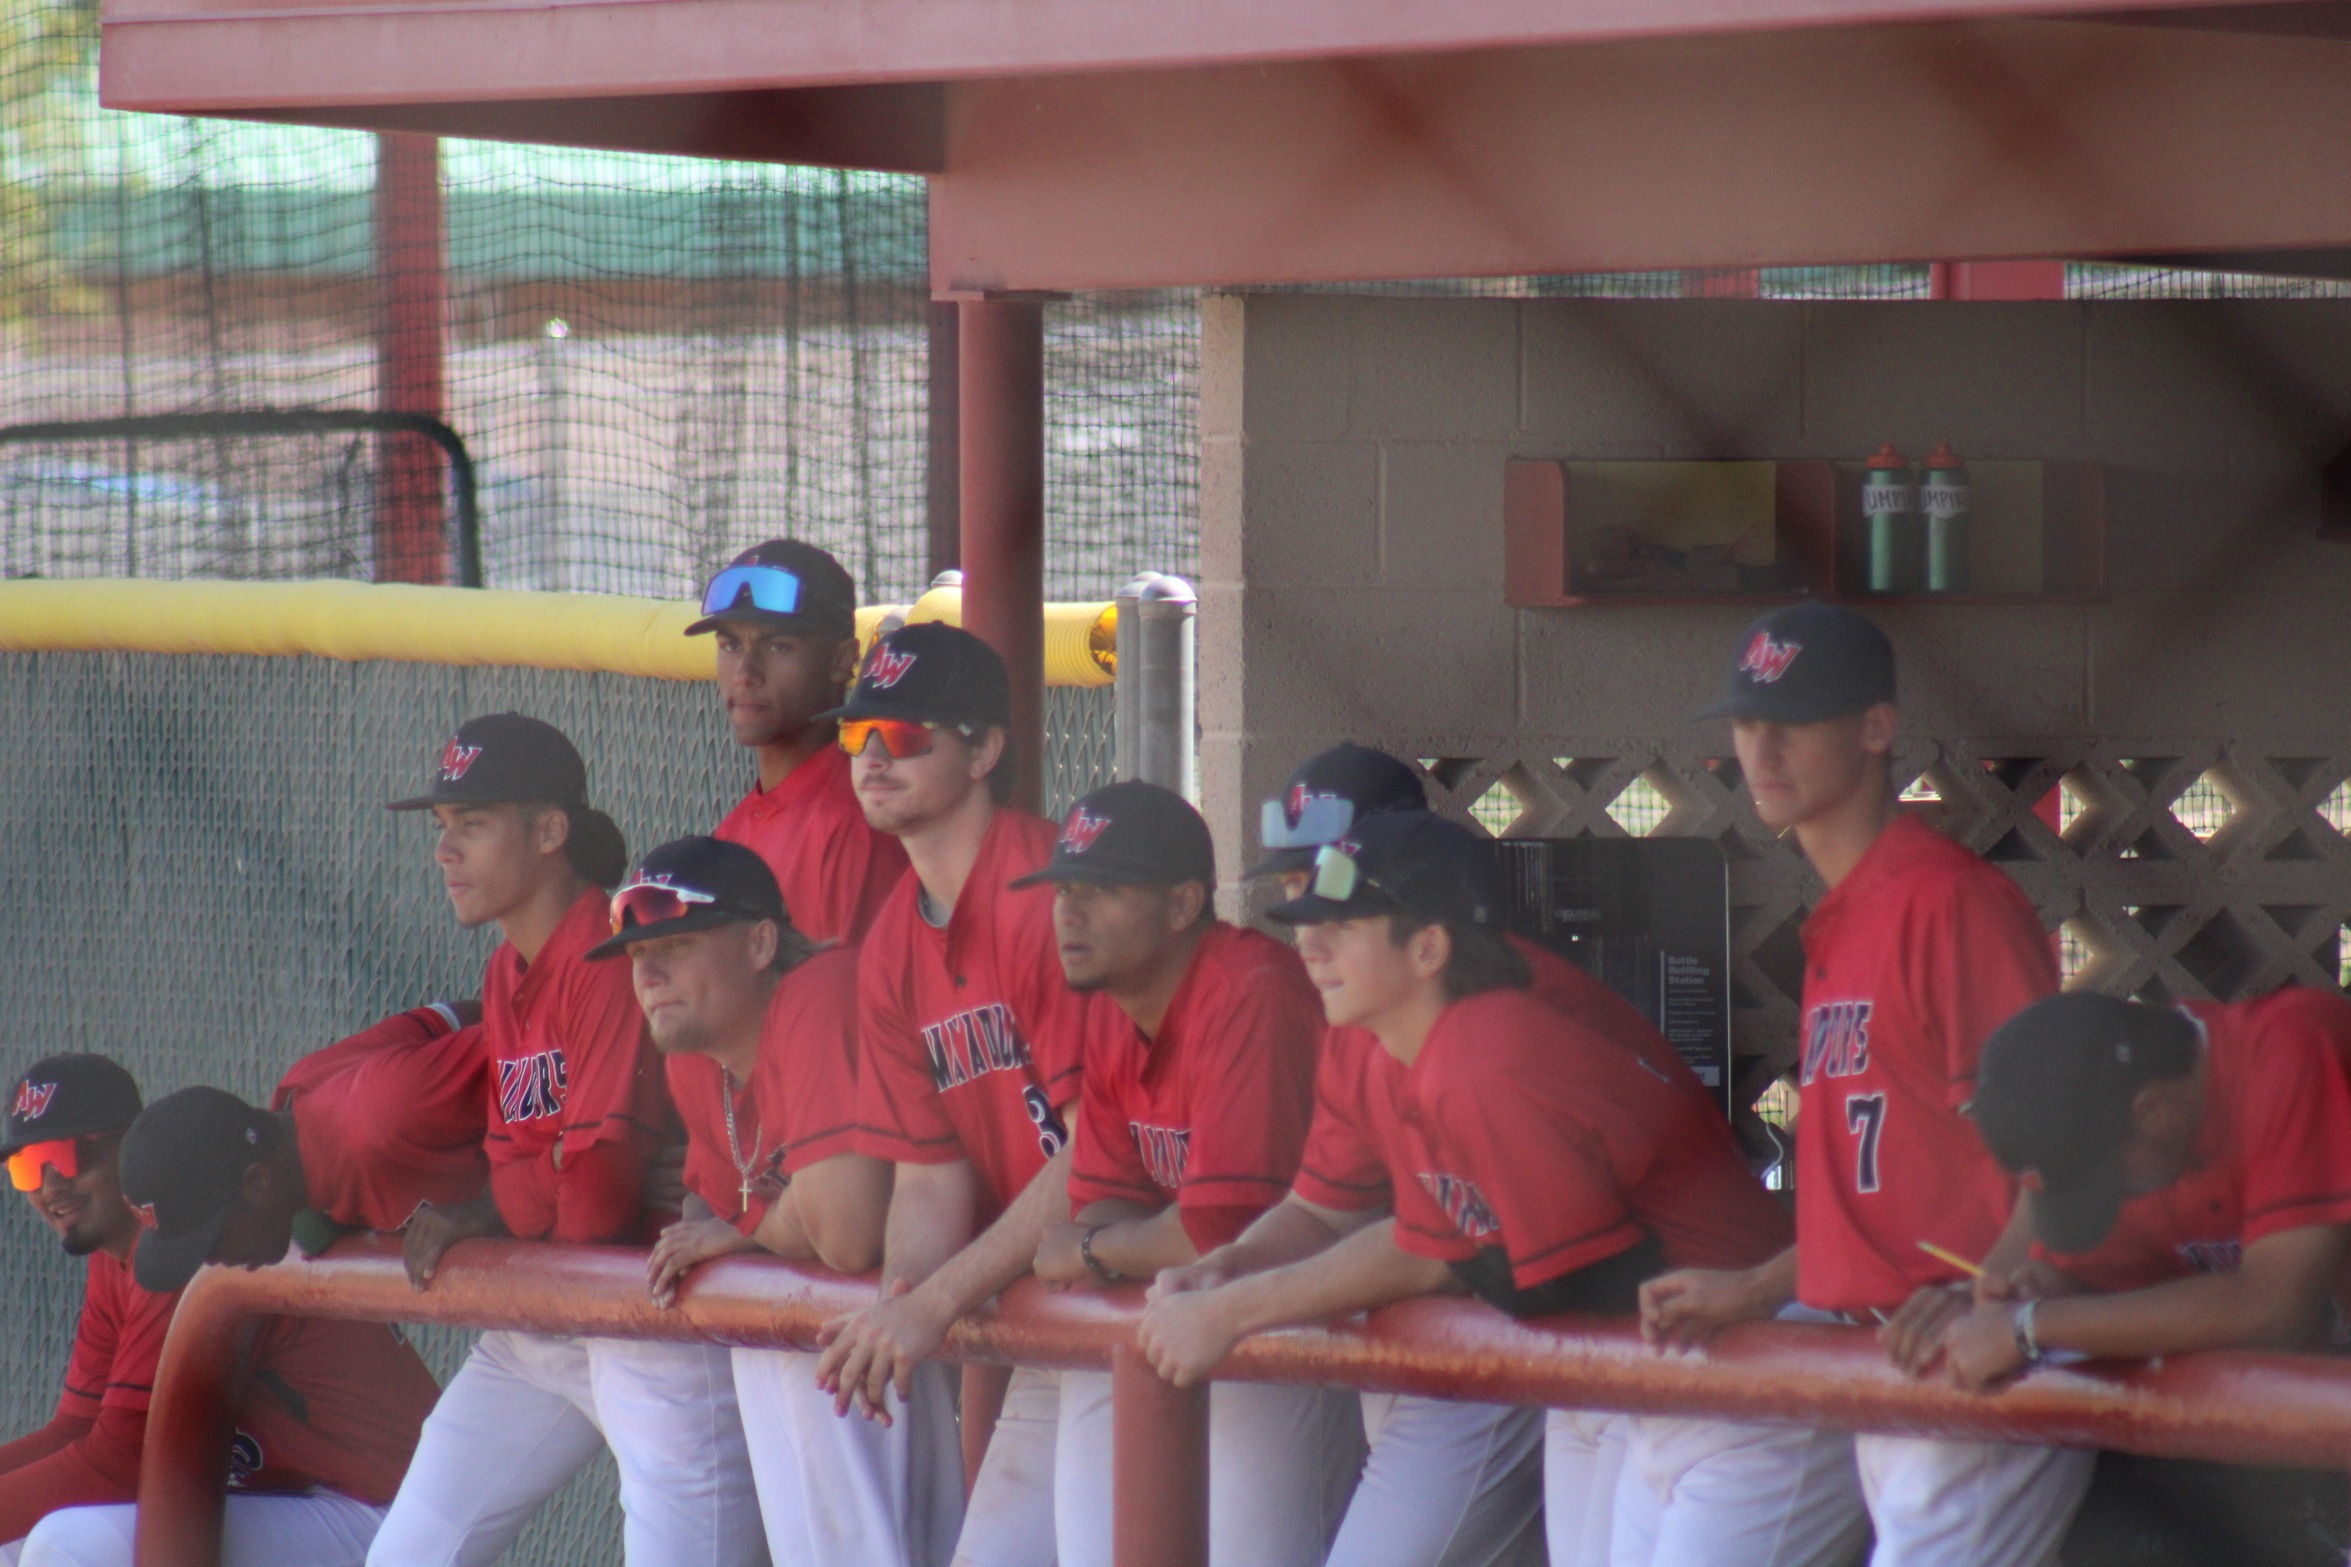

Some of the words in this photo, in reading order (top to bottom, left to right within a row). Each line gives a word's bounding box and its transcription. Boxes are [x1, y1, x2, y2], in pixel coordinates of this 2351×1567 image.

[862, 642, 918, 689] AW
[1739, 632, 1802, 683] AW
[438, 736, 482, 781] AW
[1059, 807, 1112, 854] AW
[1668, 956, 1699, 965] Bottle
[1668, 966, 1710, 976] Refilling
[1668, 976, 1704, 985] Station
[12, 1079, 57, 1122] AW
[1846, 1093, 1887, 1193] 7
